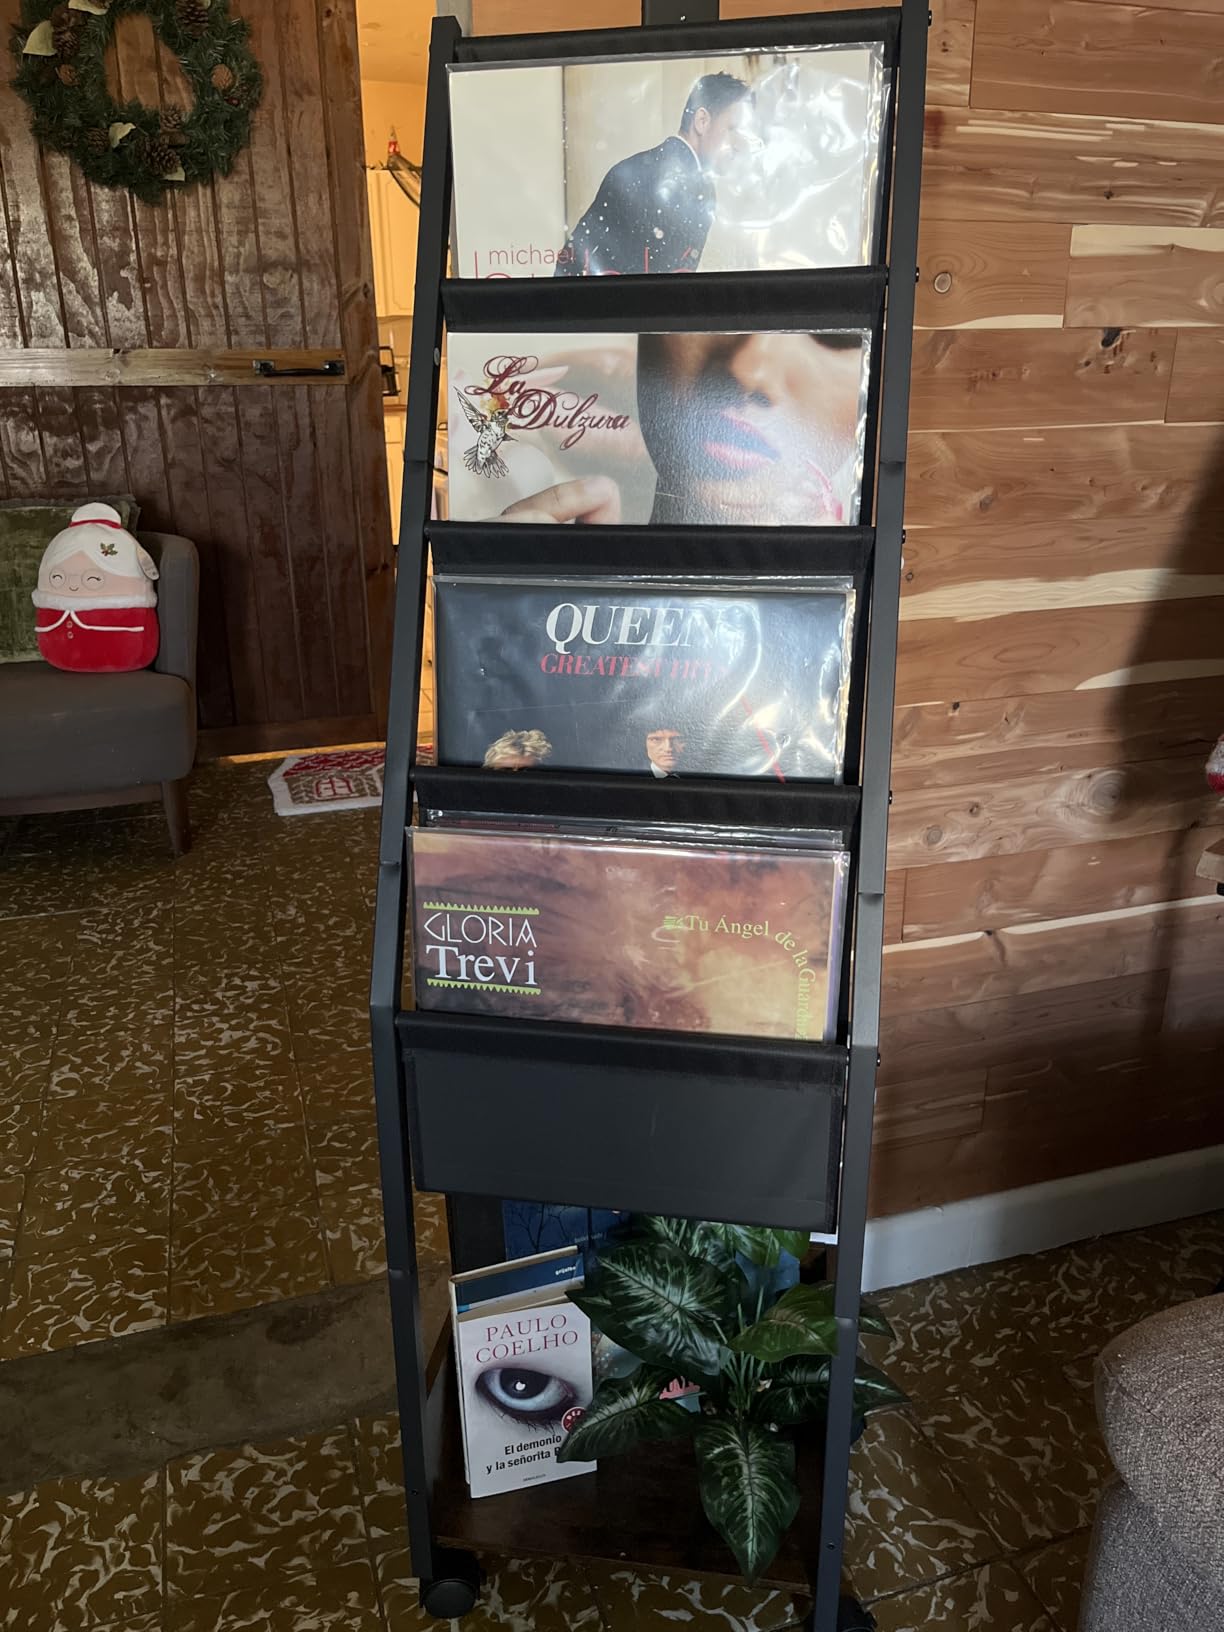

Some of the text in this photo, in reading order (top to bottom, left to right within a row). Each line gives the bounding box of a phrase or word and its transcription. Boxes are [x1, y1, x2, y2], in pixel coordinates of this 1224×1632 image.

[488, 243, 575, 265] michael
[464, 355, 539, 396] La
[506, 388, 630, 451] Dulzura
[545, 602, 724, 655] QUEEN
[423, 911, 538, 949] GLORIA
[685, 914, 709, 932] Tu
[714, 914, 770, 939] Ángel
[774, 930, 796, 952] de
[791, 949, 809, 968] la
[425, 944, 539, 986] Trevi
[475, 1330, 579, 1364] COELHO
[486, 1313, 568, 1343] PAULO
[485, 1464, 493, 1476] y
[495, 1460, 506, 1472] la
[507, 1449, 552, 1469] señorita
[504, 1444, 515, 1457] El
[516, 1434, 563, 1454] demonio
